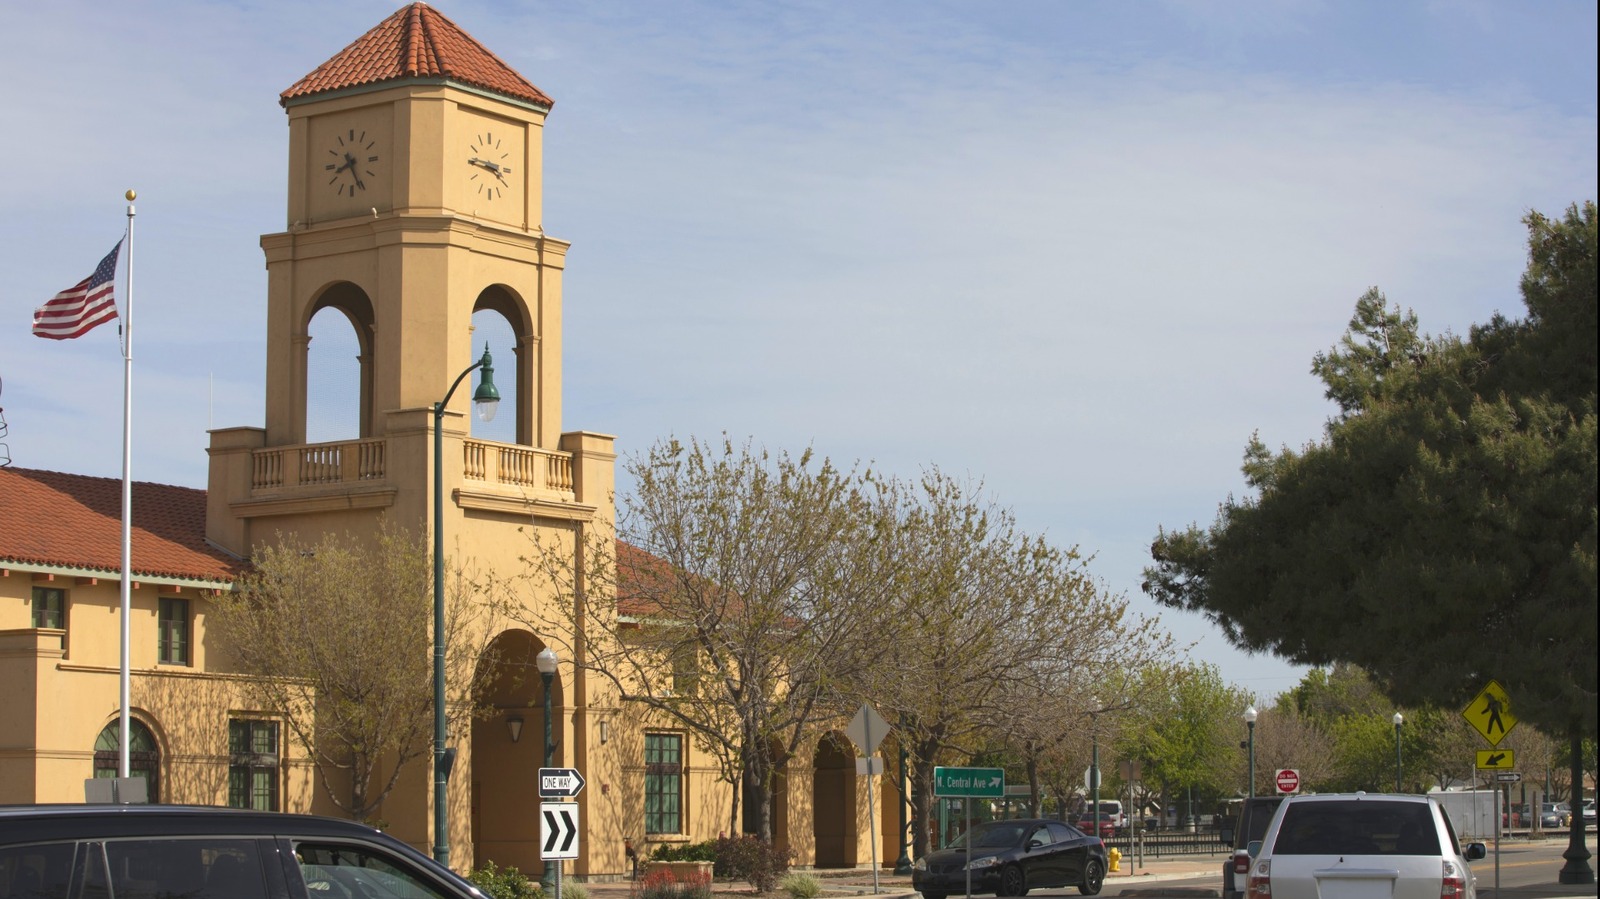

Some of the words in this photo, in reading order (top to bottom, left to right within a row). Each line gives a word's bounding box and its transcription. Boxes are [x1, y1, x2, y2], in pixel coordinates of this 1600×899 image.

[544, 777, 557, 789] ONE
[558, 777, 571, 789] WAY
[937, 776, 945, 788] N.
[947, 776, 971, 788] Central
[973, 777, 986, 789] Ave
